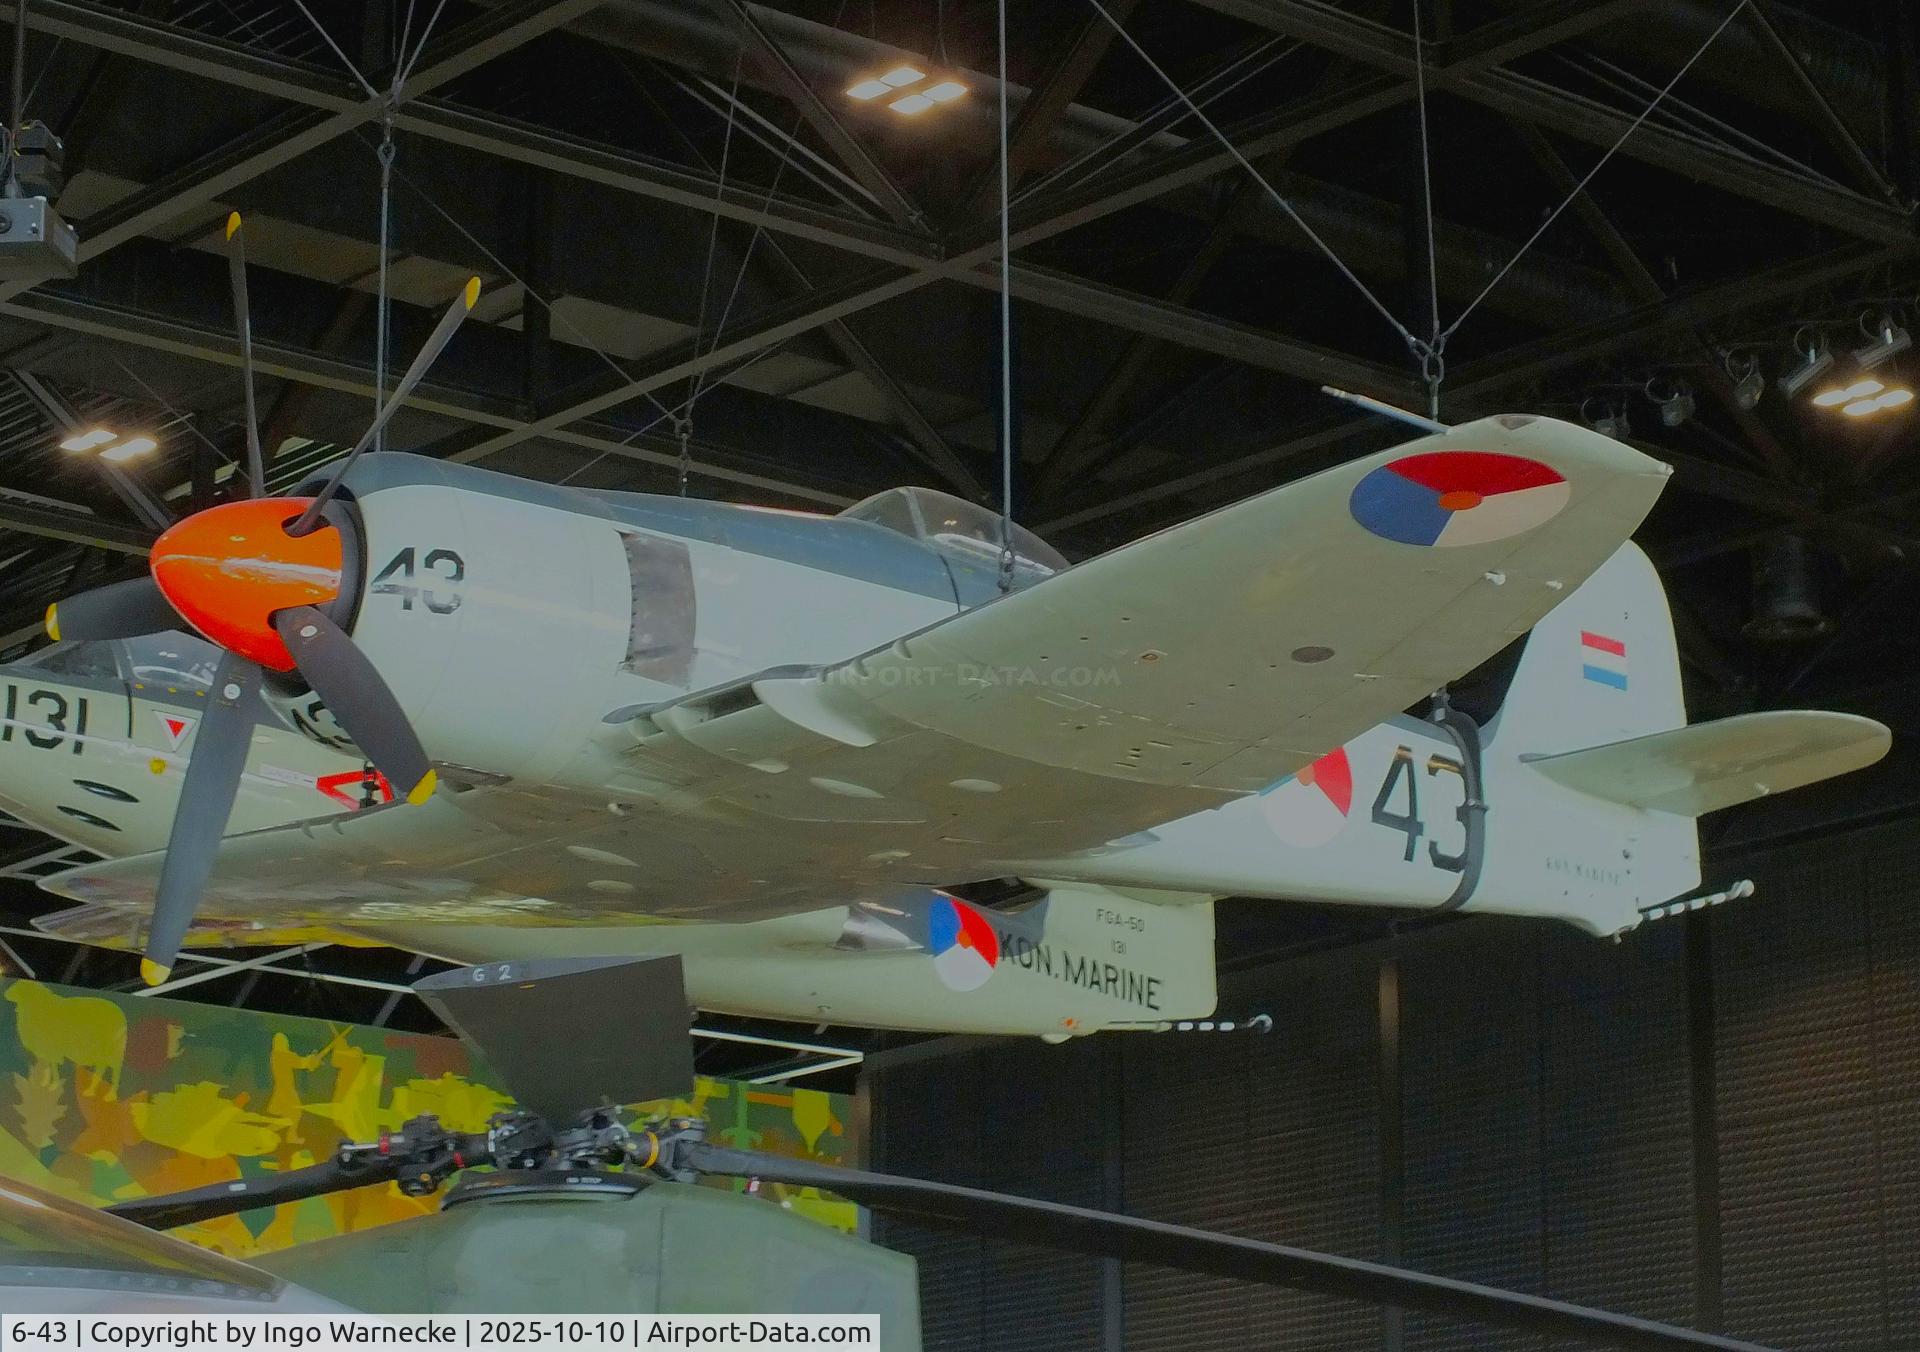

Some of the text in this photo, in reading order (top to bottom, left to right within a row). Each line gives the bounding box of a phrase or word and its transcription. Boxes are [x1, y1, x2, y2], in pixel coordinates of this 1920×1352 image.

[370, 547, 464, 615] 43
[2, 685, 87, 755] 131
[1371, 744, 1470, 873] 43
